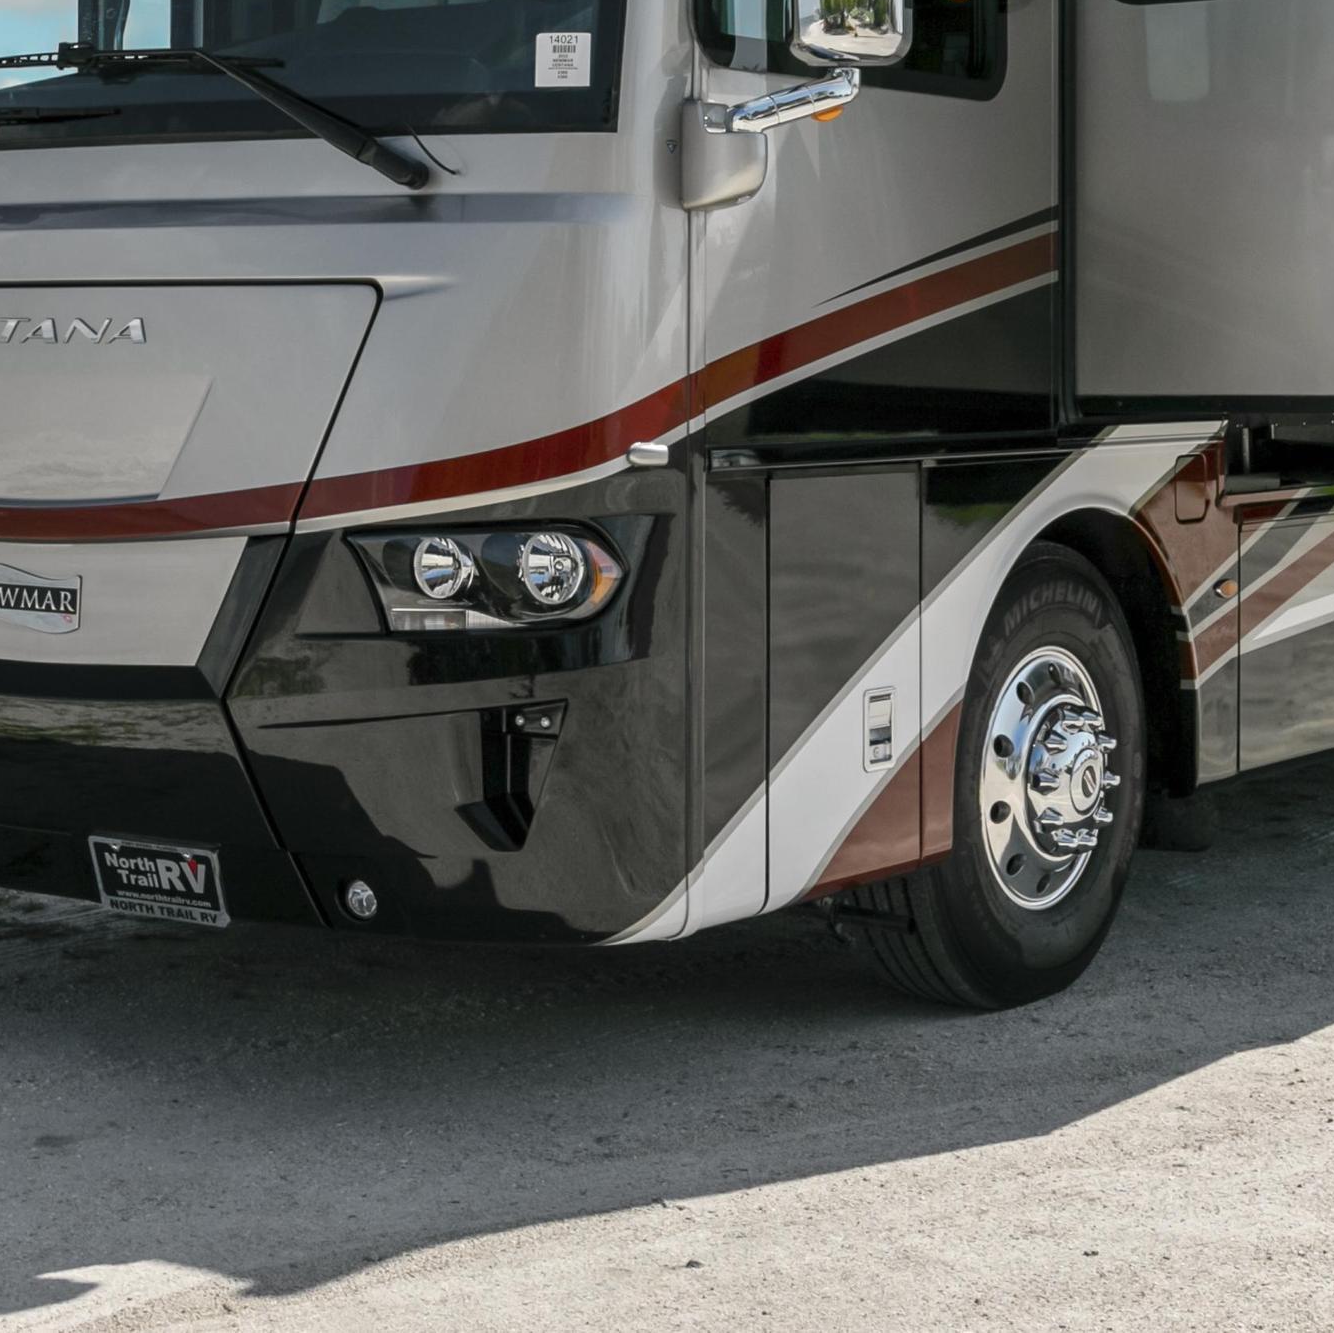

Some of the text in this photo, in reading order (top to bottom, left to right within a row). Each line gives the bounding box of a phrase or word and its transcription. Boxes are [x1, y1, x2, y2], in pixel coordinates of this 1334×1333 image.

[550, 35, 578, 44] 14021
[1004, 580, 1099, 638] MICHELIN
[104, 852, 156, 872] North
[117, 869, 159, 888] Trail
[156, 858, 206, 894] RV
[116, 890, 212, 908] www.northtrailrv.com
[109, 899, 217, 924] NORTH TRAIL RV
